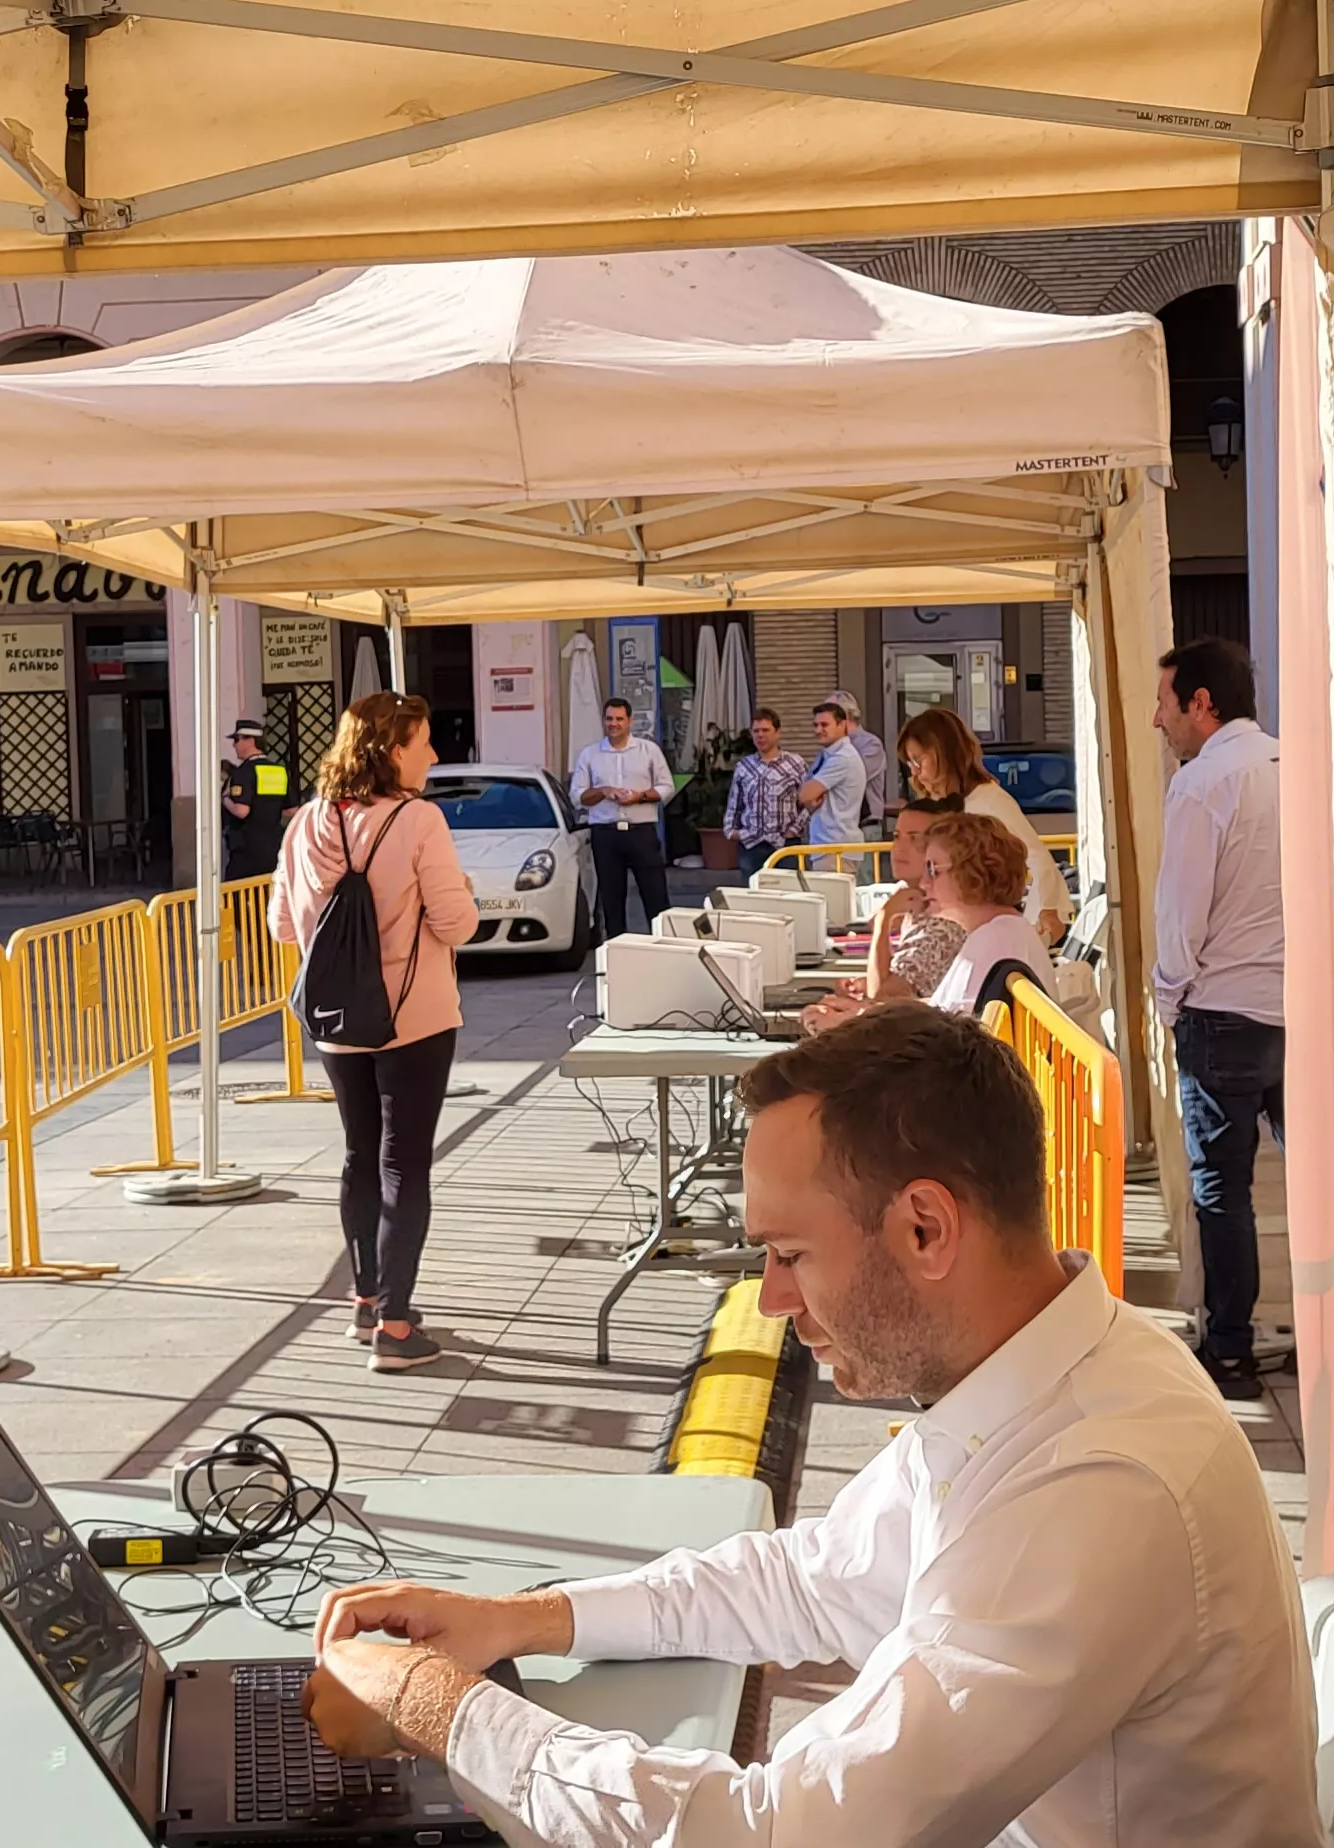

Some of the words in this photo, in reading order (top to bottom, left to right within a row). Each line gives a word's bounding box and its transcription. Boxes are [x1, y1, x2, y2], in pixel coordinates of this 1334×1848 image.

[1016, 455, 1109, 472] MASTERTENT
[1, 632, 18, 644] TE
[5, 648, 64, 659] RECUERDO
[8, 661, 59, 673] AMANDO
